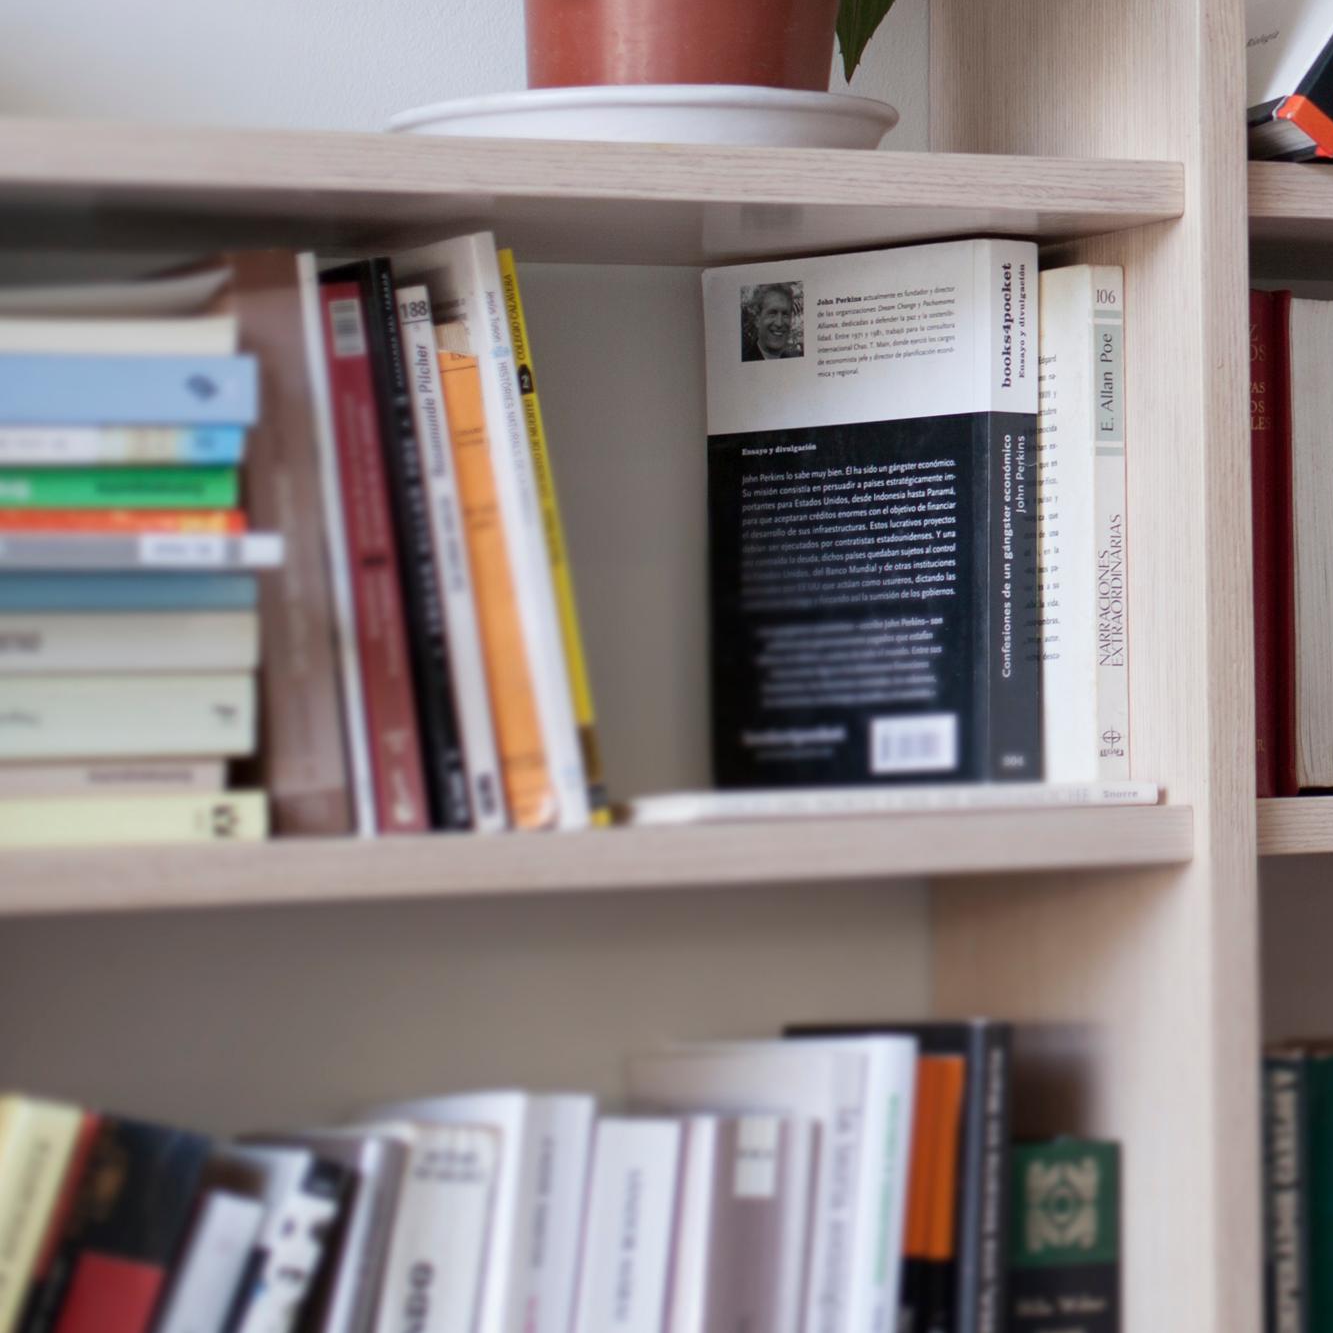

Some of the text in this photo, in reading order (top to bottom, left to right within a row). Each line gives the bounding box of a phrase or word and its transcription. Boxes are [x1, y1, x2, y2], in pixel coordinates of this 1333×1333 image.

[401, 300, 428, 319] 188
[1001, 263, 1014, 389] books4pocket
[1018, 264, 1027, 379] Ensayo divulgación
[1096, 289, 1117, 305] 106
[414, 343, 433, 395] Pilcher
[521, 374, 530, 388] 2
[1099, 332, 1115, 433] E. Allan Poe
[742, 443, 817, 456] Ensayo divulgación
[760, 462, 917, 482] Perkins sabe muy sido gángster
[1015, 434, 1027, 515] John Perkins
[1001, 433, 1014, 678] Confesiones de un gángster económico
[1108, 513, 1125, 668] EXTRAORDINARIAS
[1097, 549, 1111, 667] NARRACIONES
